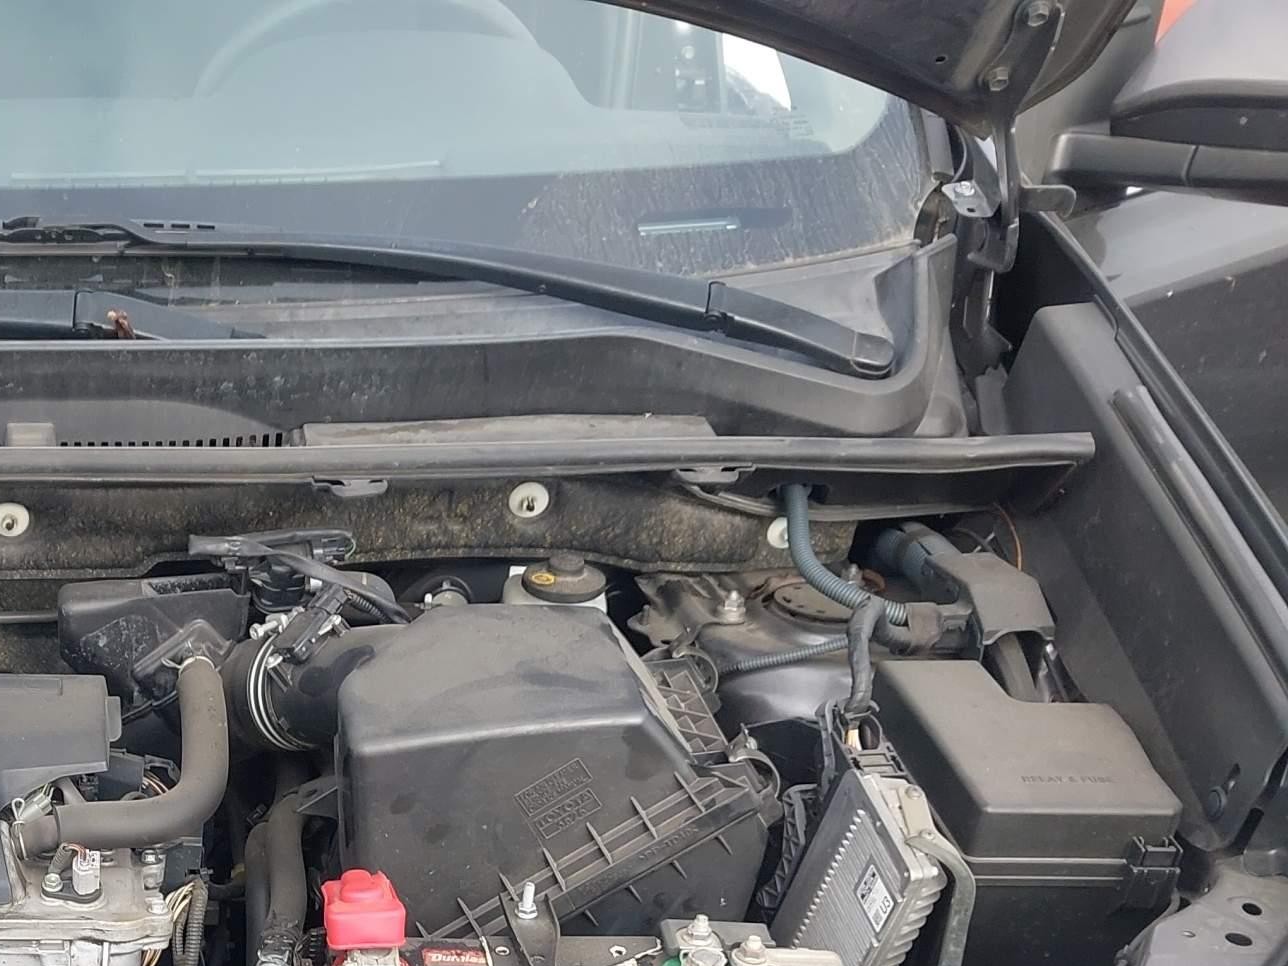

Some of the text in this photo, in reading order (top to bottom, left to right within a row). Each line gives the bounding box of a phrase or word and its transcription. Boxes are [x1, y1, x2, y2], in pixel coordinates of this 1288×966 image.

[1018, 775, 1063, 784] RELAY
[536, 791, 594, 828] TOYOTA
[879, 896, 892, 914] U3
[431, 952, 487, 964] Duralas
